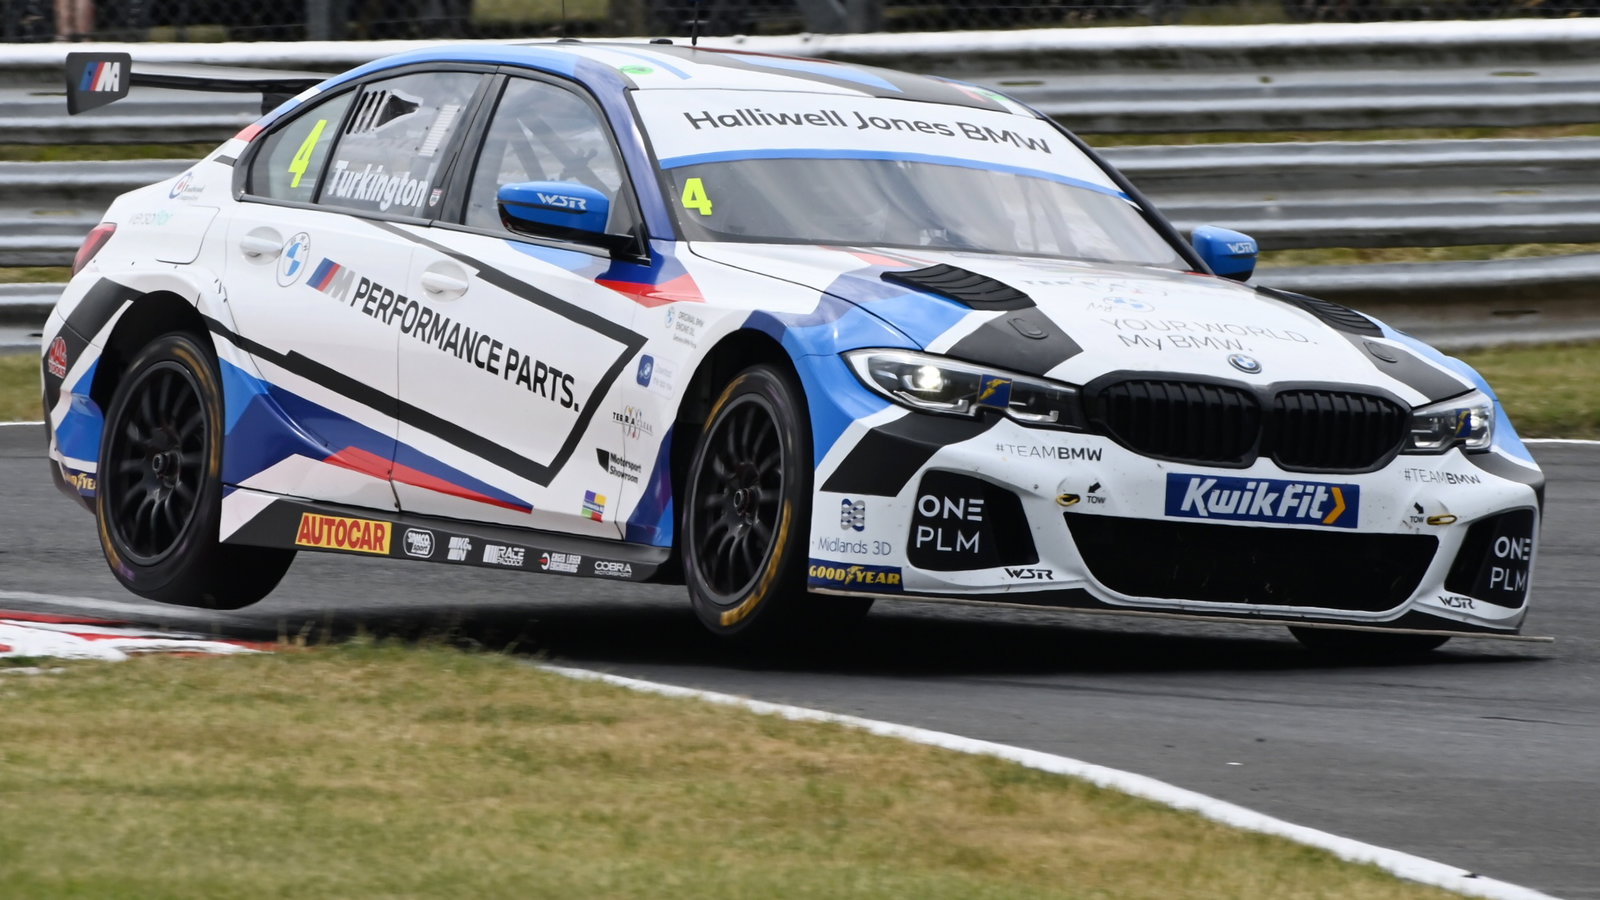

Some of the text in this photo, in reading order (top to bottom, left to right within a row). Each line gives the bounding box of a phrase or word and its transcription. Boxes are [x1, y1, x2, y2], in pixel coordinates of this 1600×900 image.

[95, 62, 120, 91] M
[683, 108, 1052, 154] Halliwell Jones BMW
[288, 119, 327, 188] 4
[328, 160, 429, 212] Turkington
[536, 192, 587, 211] WSR
[681, 177, 713, 216] 4
[1101, 318, 1318, 345] YOUR WORLD.
[350, 276, 503, 376] PERFORMANCE
[504, 348, 579, 412] PARTS.
[1118, 334, 1253, 352] My BMW.
[996, 443, 1103, 461] #TEAMBMW
[610, 452, 642, 473] Motorsport
[609, 465, 639, 484] Showroom
[1404, 467, 1481, 485] #TEAMBMW
[918, 494, 985, 521] ONE
[1087, 495, 1106, 504] TOW
[1410, 515, 1425, 523] TOW
[297, 515, 385, 552] AUTOCAR
[916, 525, 980, 553] PLM
[498, 546, 525, 560] RACE
[818, 537, 892, 556] Midlands 3D
[1494, 536, 1532, 560] ONE
[594, 561, 632, 573] COBRA
[594, 569, 633, 578] MOTORSPORT
[809, 565, 900, 585] GOODYEAR
[1004, 567, 1054, 580] WSR
[1489, 566, 1527, 592] PLM
[1438, 596, 1475, 609] WSR
